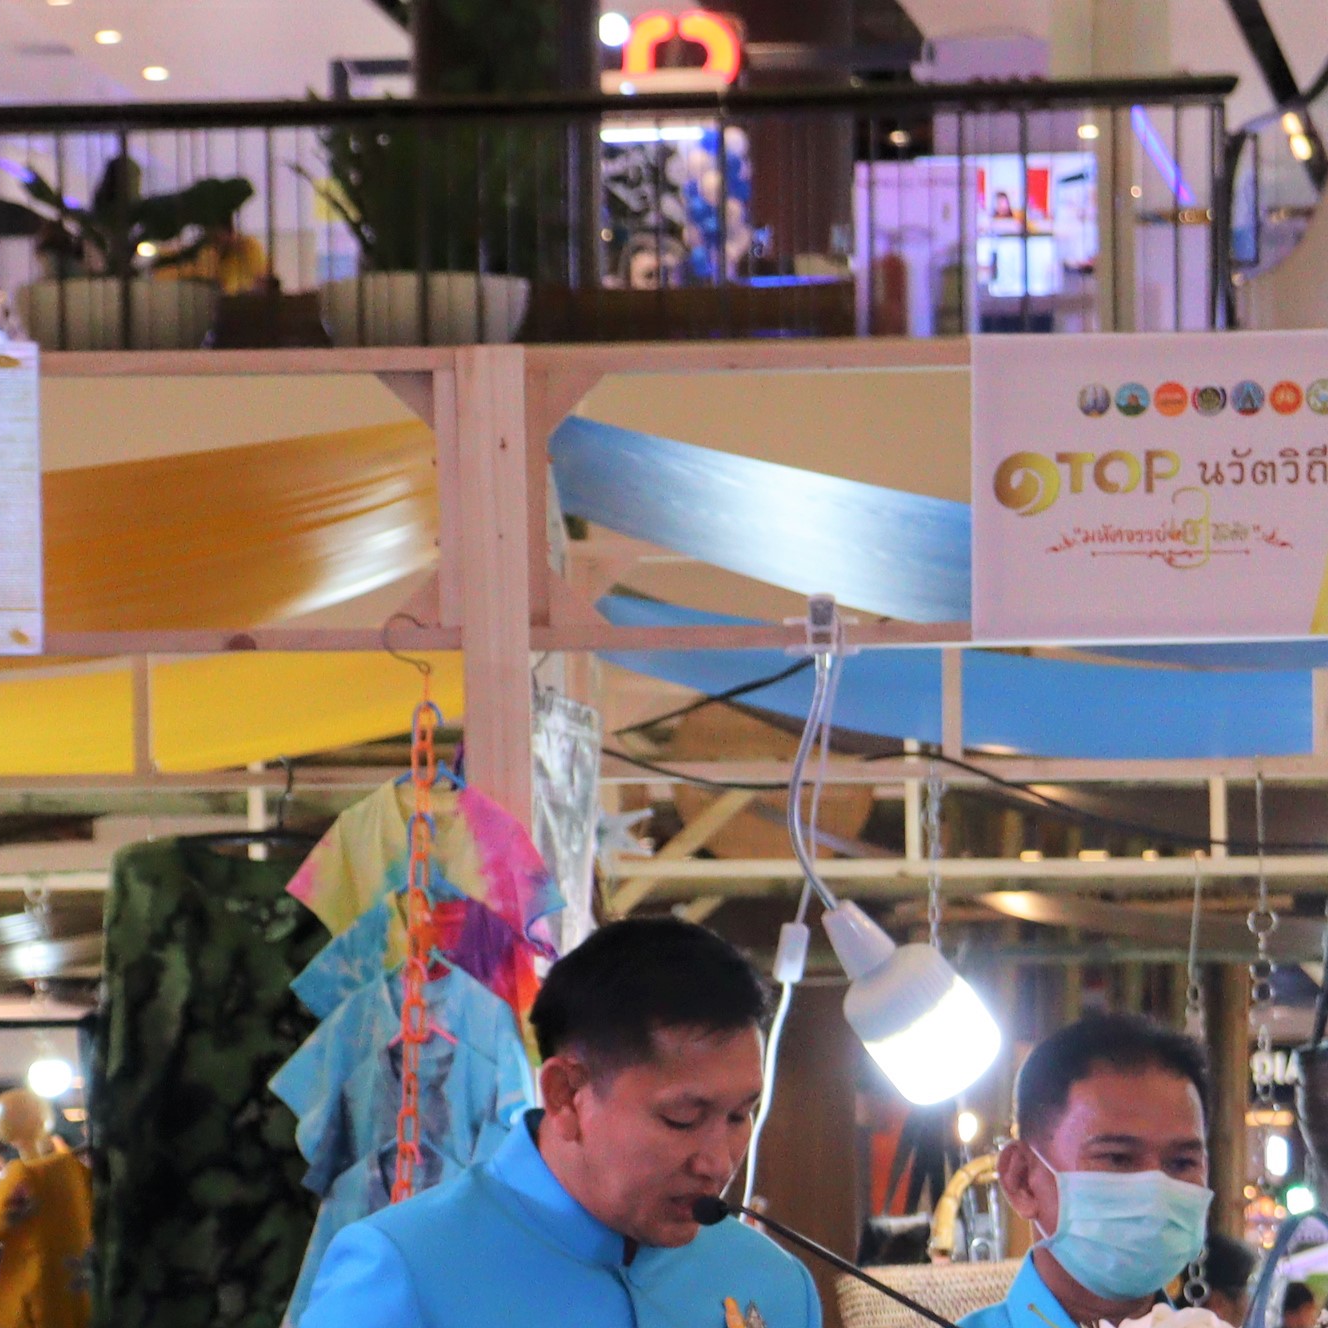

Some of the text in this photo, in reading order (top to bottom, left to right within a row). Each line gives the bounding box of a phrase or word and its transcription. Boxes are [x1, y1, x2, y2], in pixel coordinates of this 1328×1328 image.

[993, 444, 1328, 517] OTOP นวัตวิถี
